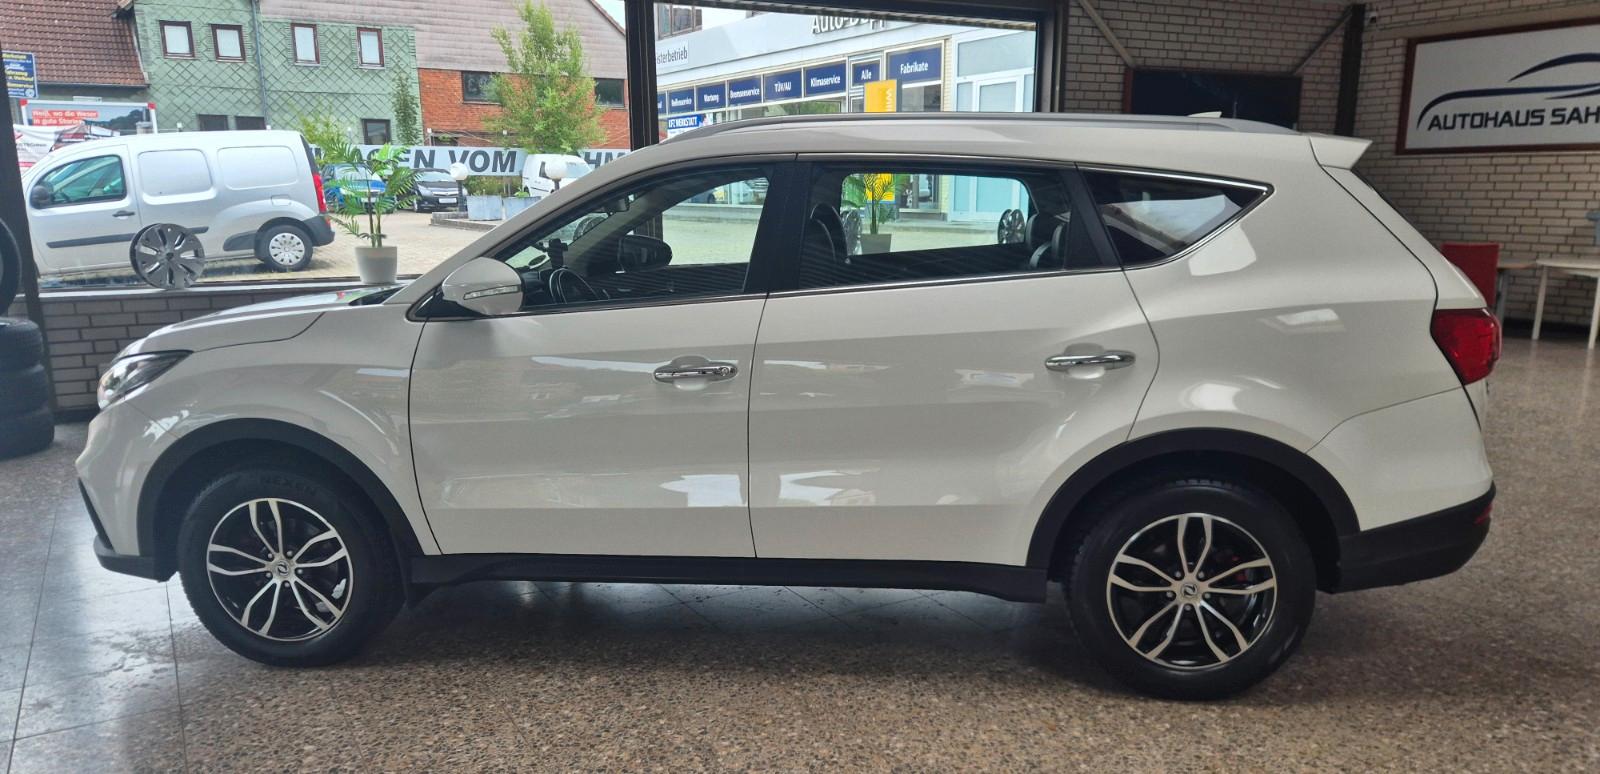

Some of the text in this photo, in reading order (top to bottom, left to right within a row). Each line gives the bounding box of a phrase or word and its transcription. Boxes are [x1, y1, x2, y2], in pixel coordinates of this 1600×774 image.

[861, 69, 872, 80] Alle
[900, 60, 929, 75] Fabrikate
[810, 74, 841, 88] Klimaservice
[730, 87, 760, 99] Bremsenservice
[1427, 109, 1545, 131] AUTOHAUS
[448, 149, 517, 173] VOM
